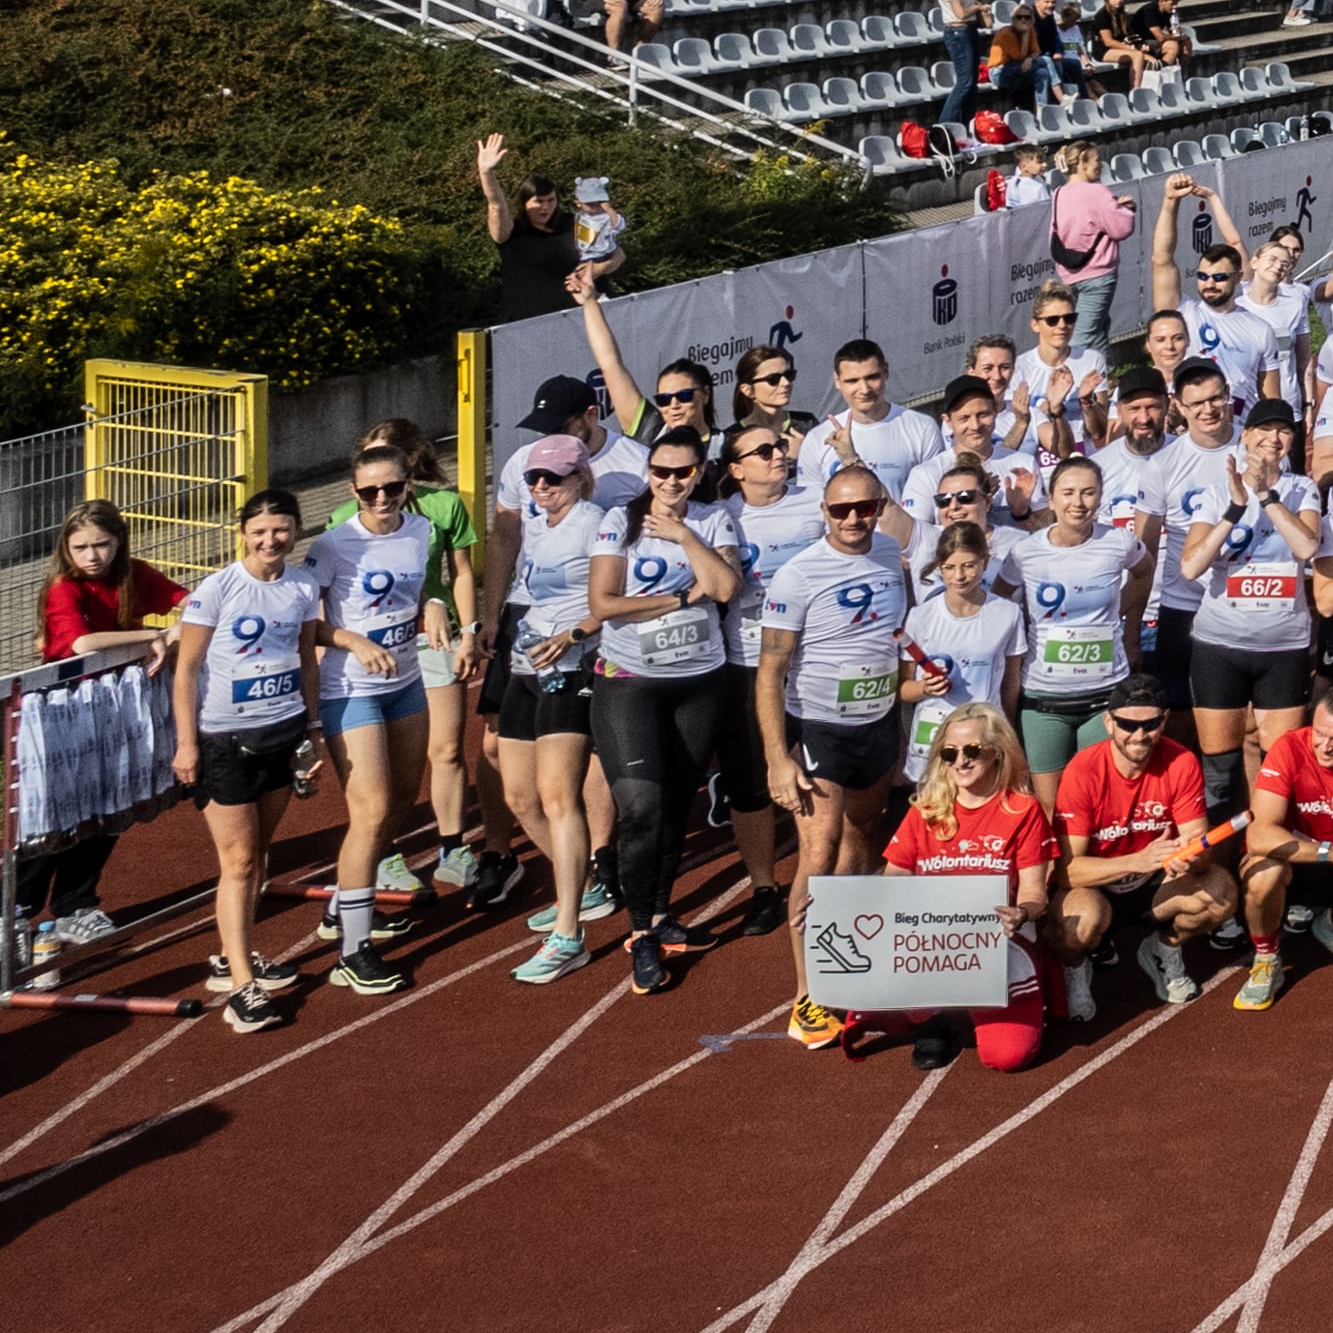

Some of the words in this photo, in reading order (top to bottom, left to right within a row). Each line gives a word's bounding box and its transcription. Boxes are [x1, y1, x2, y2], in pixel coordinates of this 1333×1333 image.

[1249, 195, 1286, 217] Biegajmy
[1249, 220, 1274, 237] razem
[1011, 257, 1056, 282] Biegajmy
[932, 279, 957, 325] PKO
[923, 339, 942, 355] Bank
[944, 332, 966, 349] Polski
[1241, 579, 1283, 597] 66/2
[381, 623, 416, 645] 46/3
[655, 626, 698, 647] 64/3
[1058, 644, 1101, 663] 62/3
[248, 678, 293, 700] 46/5
[853, 679, 891, 699] 62/4
[918, 854, 1011, 872] Wolontariusz
[894, 913, 919, 926] Bieg
[921, 912, 1001, 925] Charytatywny
[893, 930, 1002, 953] PÓŁNOCNY
[893, 953, 981, 974] POMAGA
